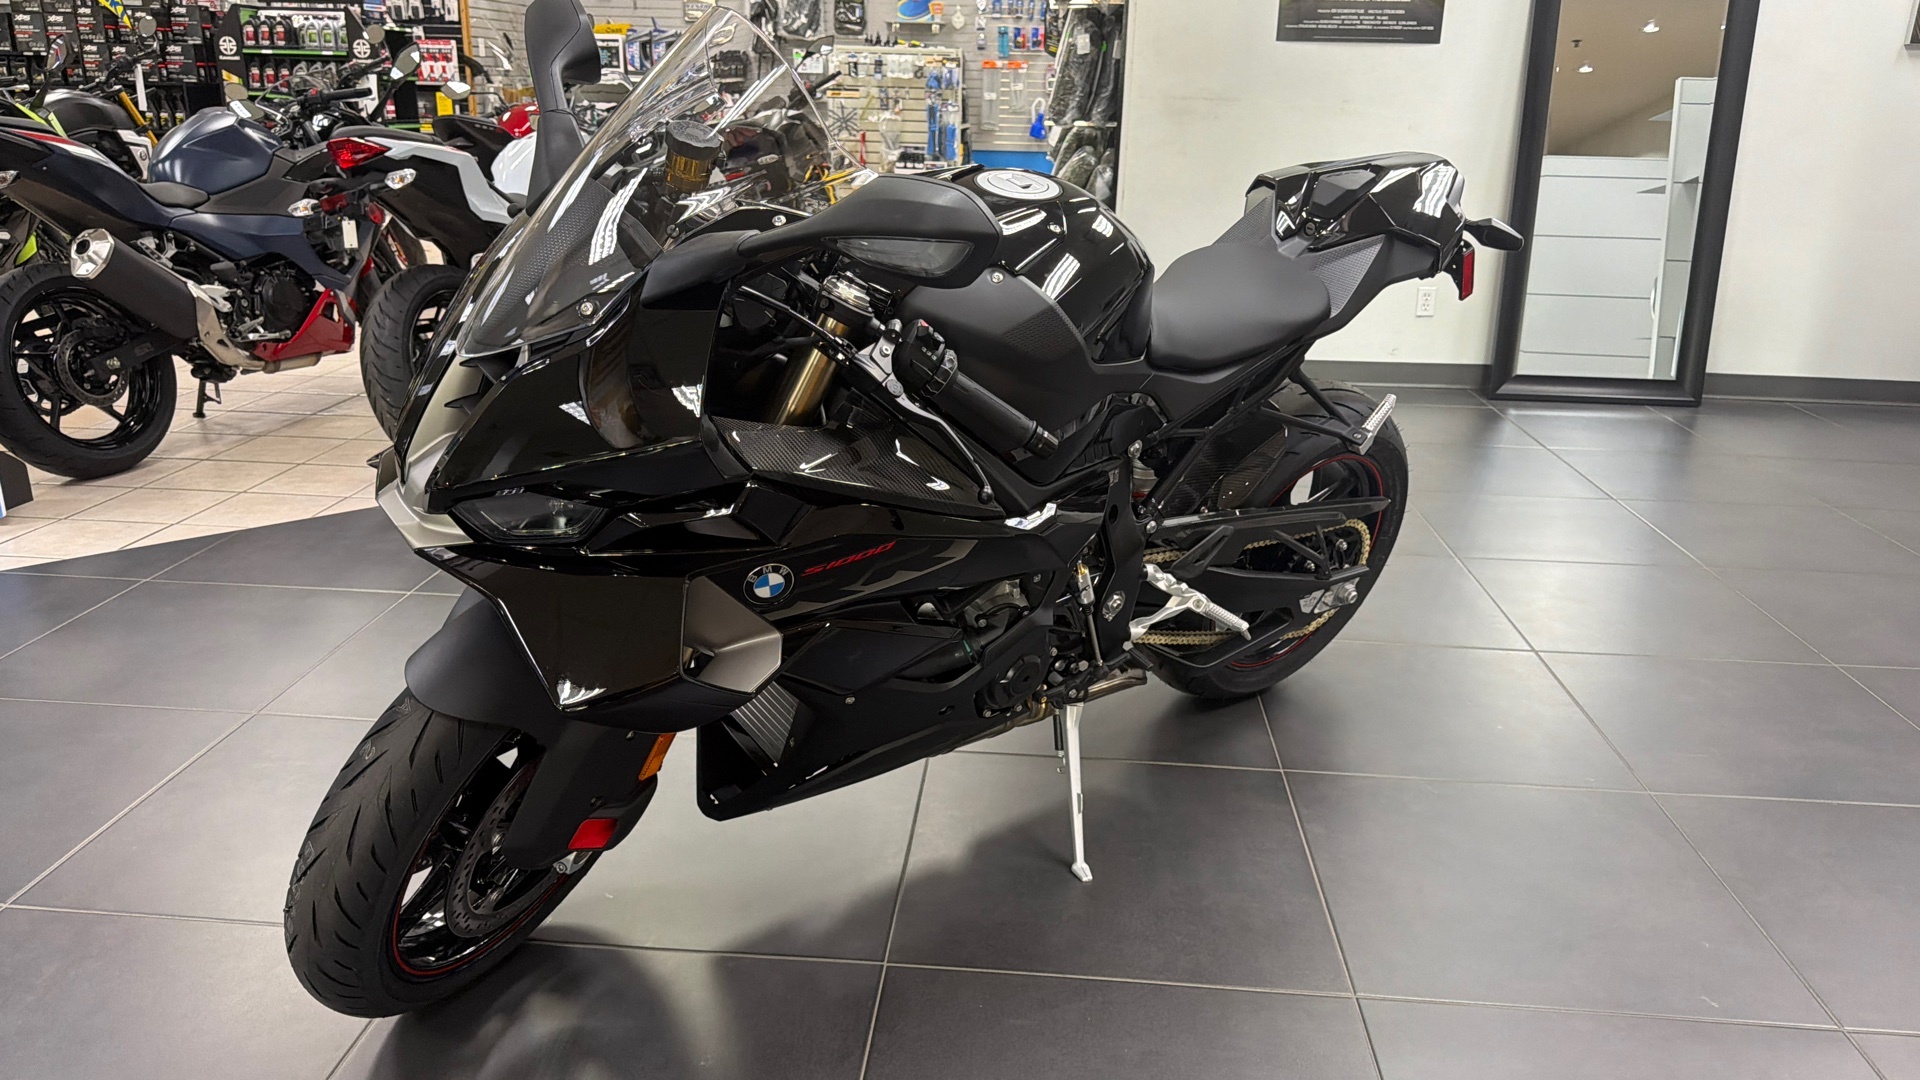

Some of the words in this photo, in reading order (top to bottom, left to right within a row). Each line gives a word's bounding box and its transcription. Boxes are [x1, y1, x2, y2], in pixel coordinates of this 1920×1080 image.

[14, 13, 31, 21] XPS
[47, 14, 64, 22] XPS
[801, 541, 897, 577] S1000
[747, 565, 790, 584] BMW
